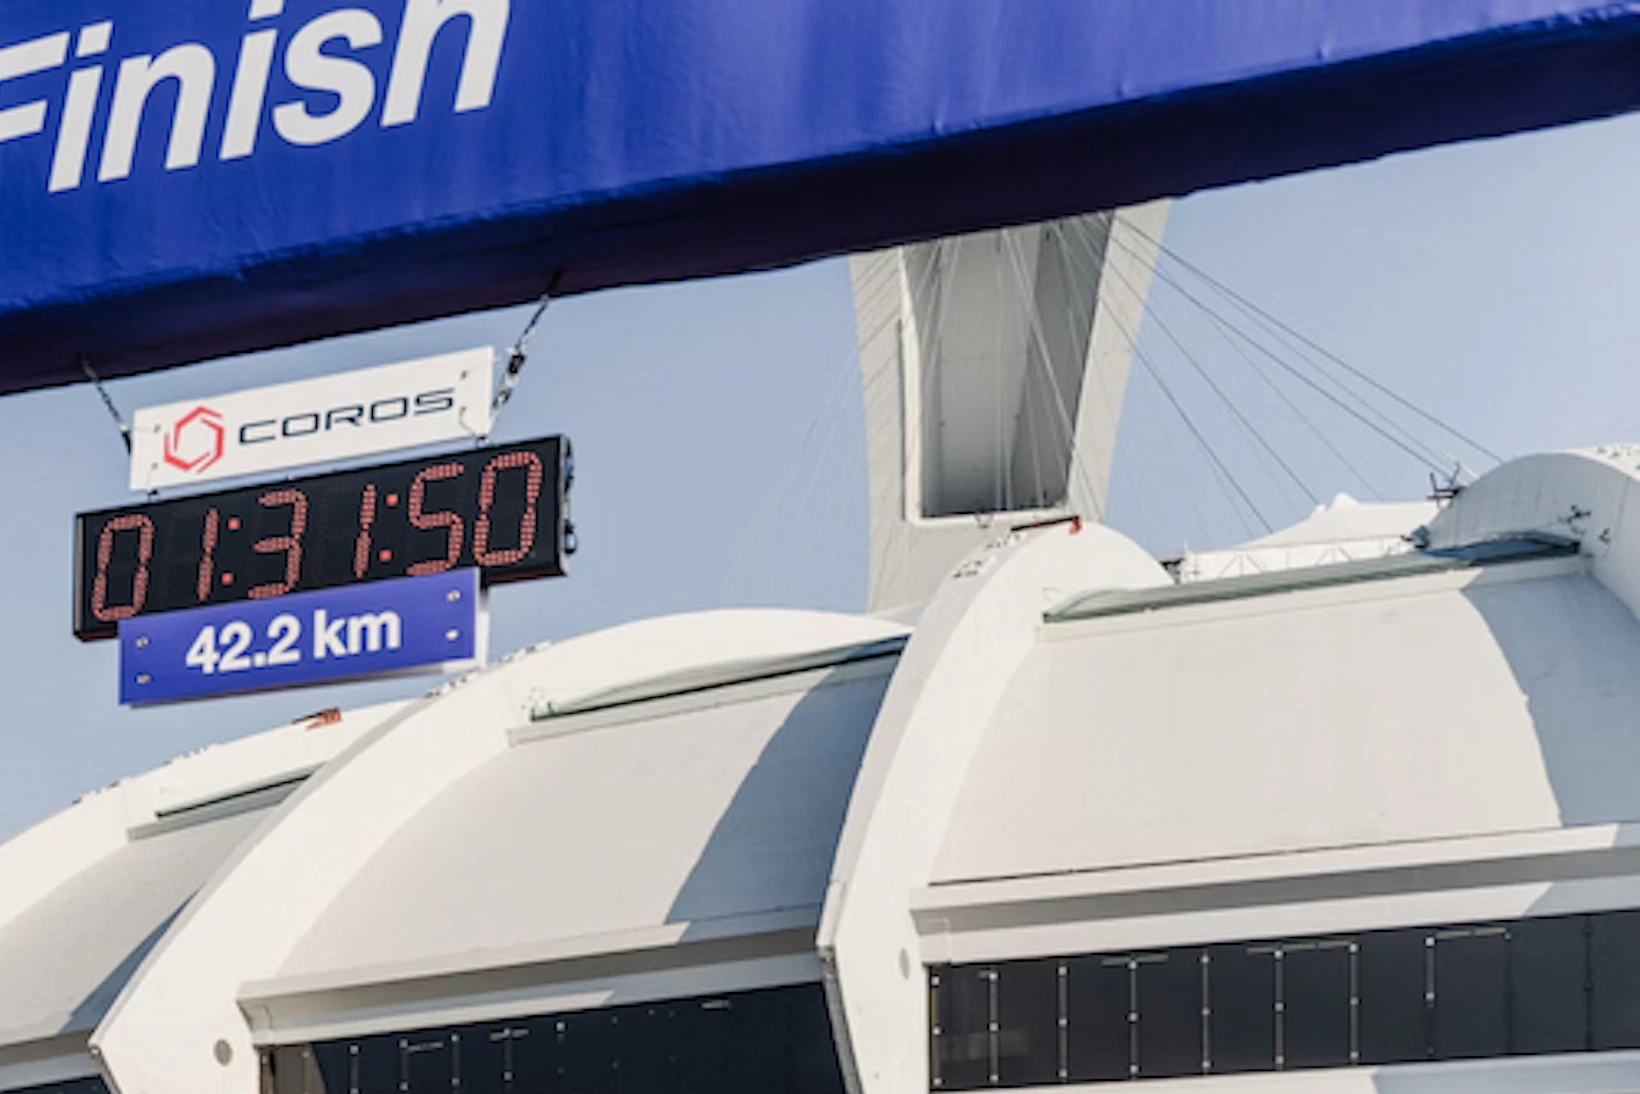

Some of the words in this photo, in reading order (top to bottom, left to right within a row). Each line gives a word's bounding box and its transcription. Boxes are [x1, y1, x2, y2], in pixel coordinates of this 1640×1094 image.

[239, 388, 455, 446] COROS
[91, 450, 542, 623] 01:31:50
[185, 614, 301, 674] 42.2
[313, 609, 400, 657] km
